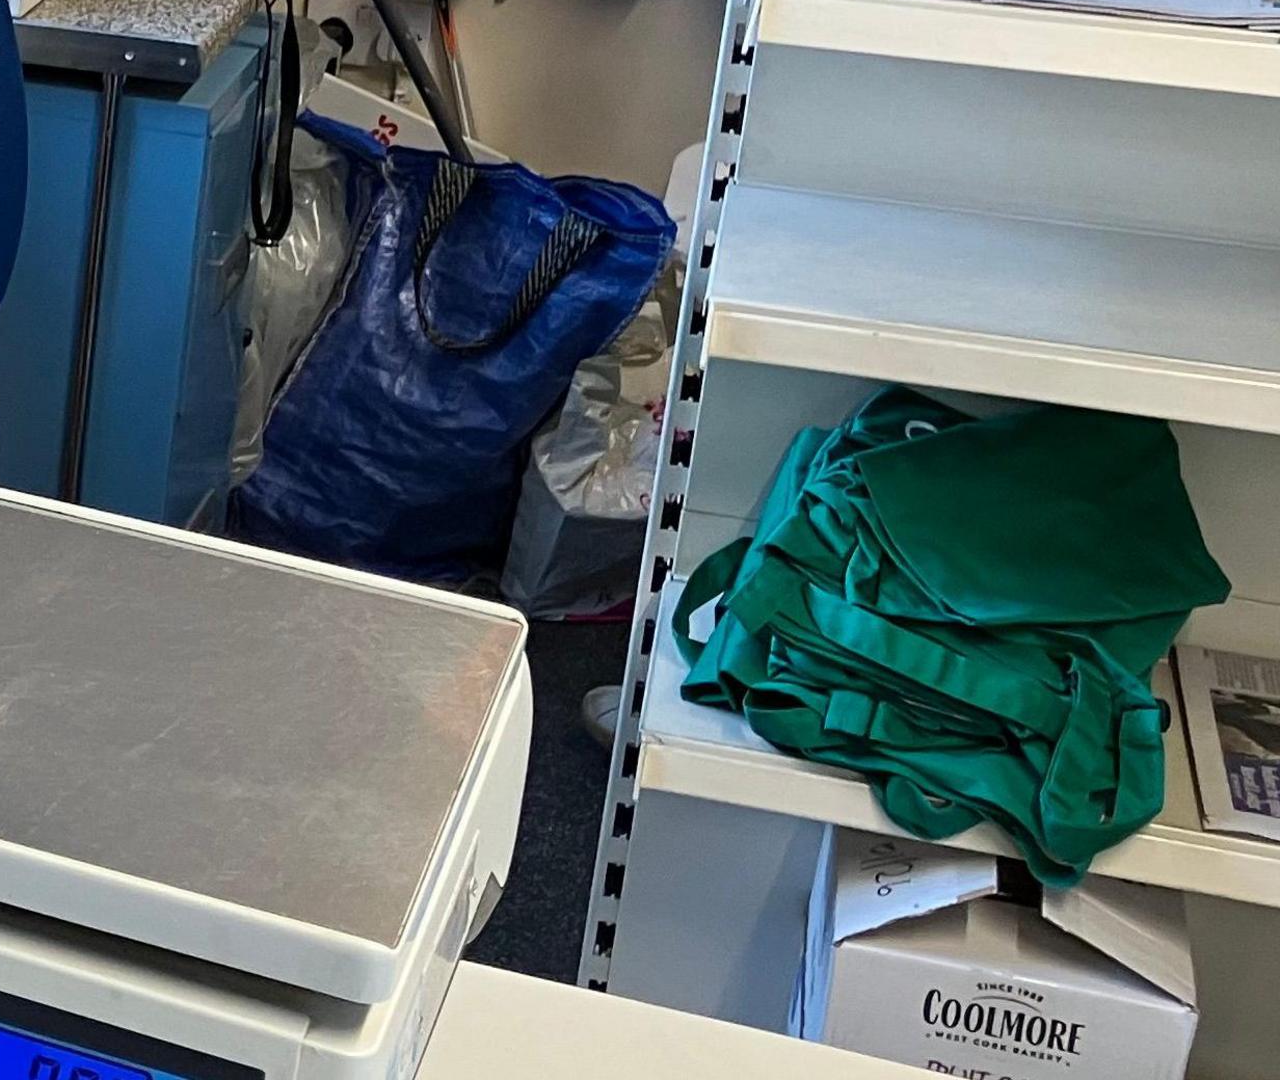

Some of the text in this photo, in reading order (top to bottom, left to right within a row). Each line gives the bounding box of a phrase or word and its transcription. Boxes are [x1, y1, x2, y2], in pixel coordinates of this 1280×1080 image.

[977, 982, 1013, 992] SINCE
[922, 989, 1086, 1055] COOLMORE
[935, 1031, 1063, 1063] WEST CORK BAKERY
